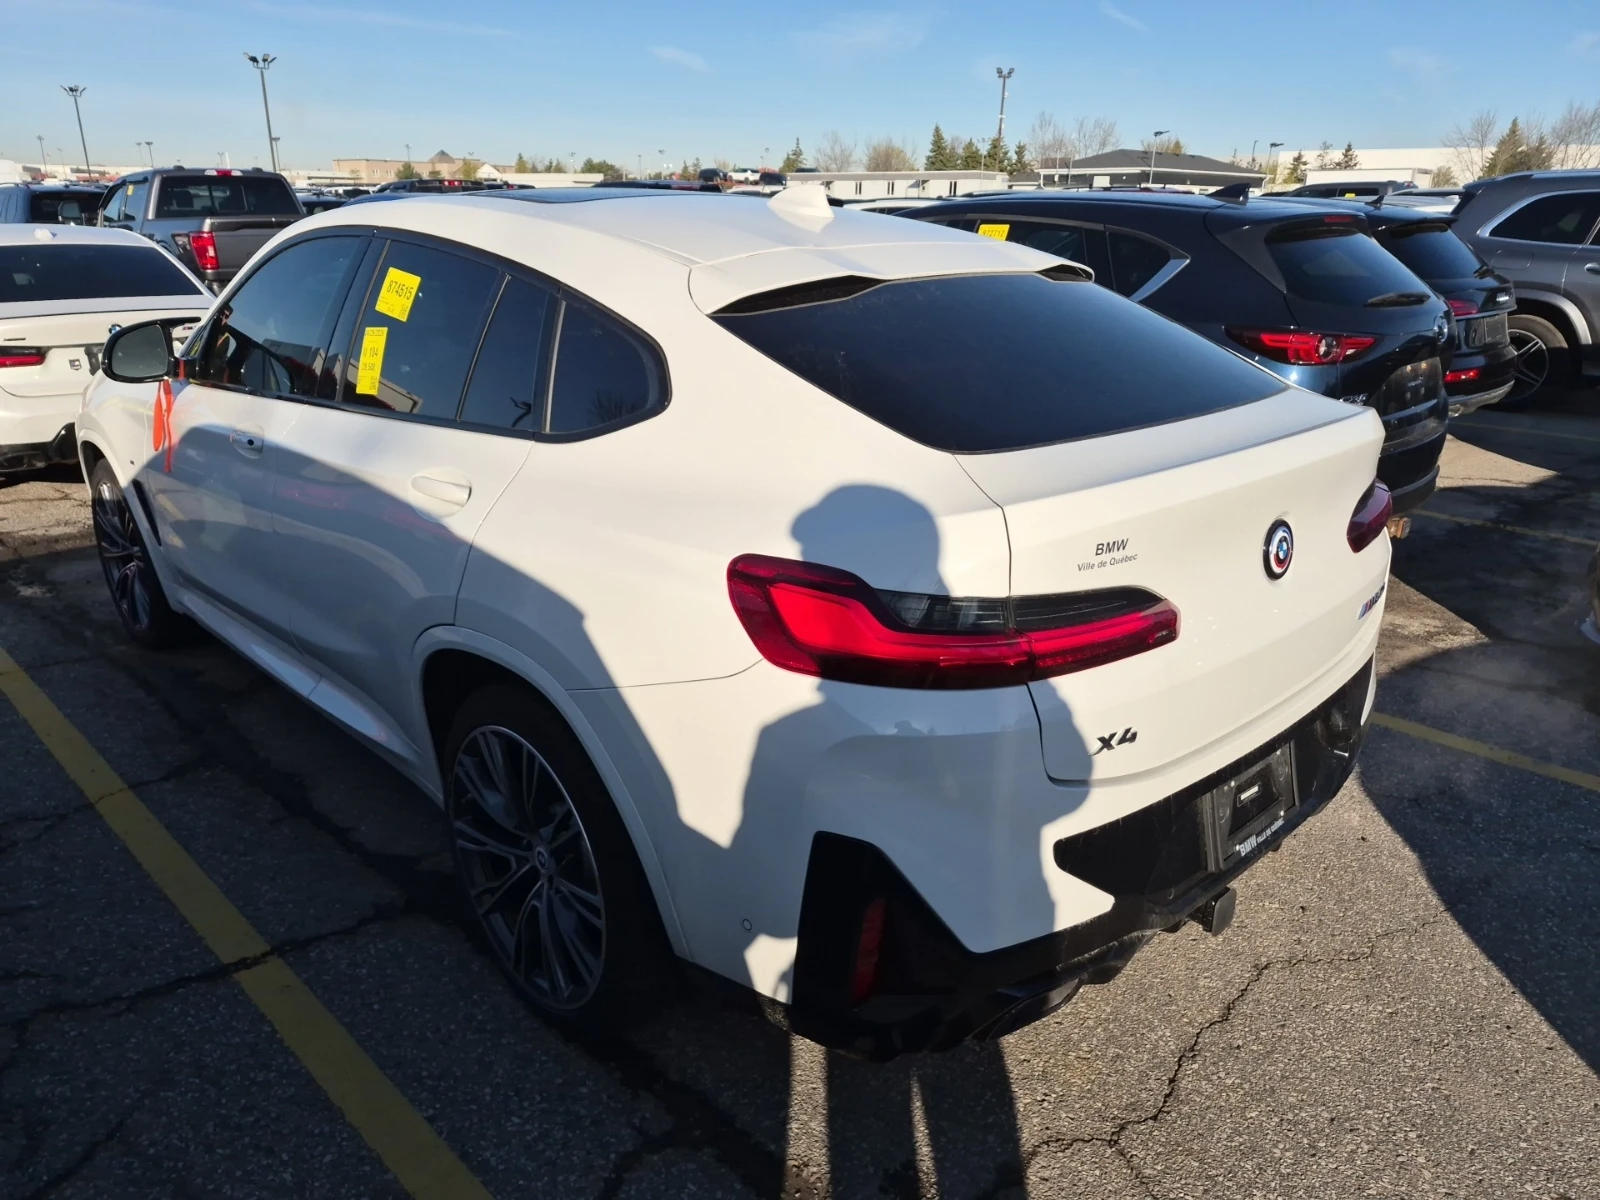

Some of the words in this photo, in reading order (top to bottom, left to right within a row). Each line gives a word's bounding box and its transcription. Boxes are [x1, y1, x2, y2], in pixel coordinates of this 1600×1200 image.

[387, 280, 413, 300] 874515
[1095, 537, 1129, 556] BMW
[1077, 561, 1095, 572] Ville
[1097, 560, 1108, 569] de
[1109, 553, 1138, 566] Québec
[1090, 726, 1138, 756] X4
[1240, 834, 1256, 856] BMW
